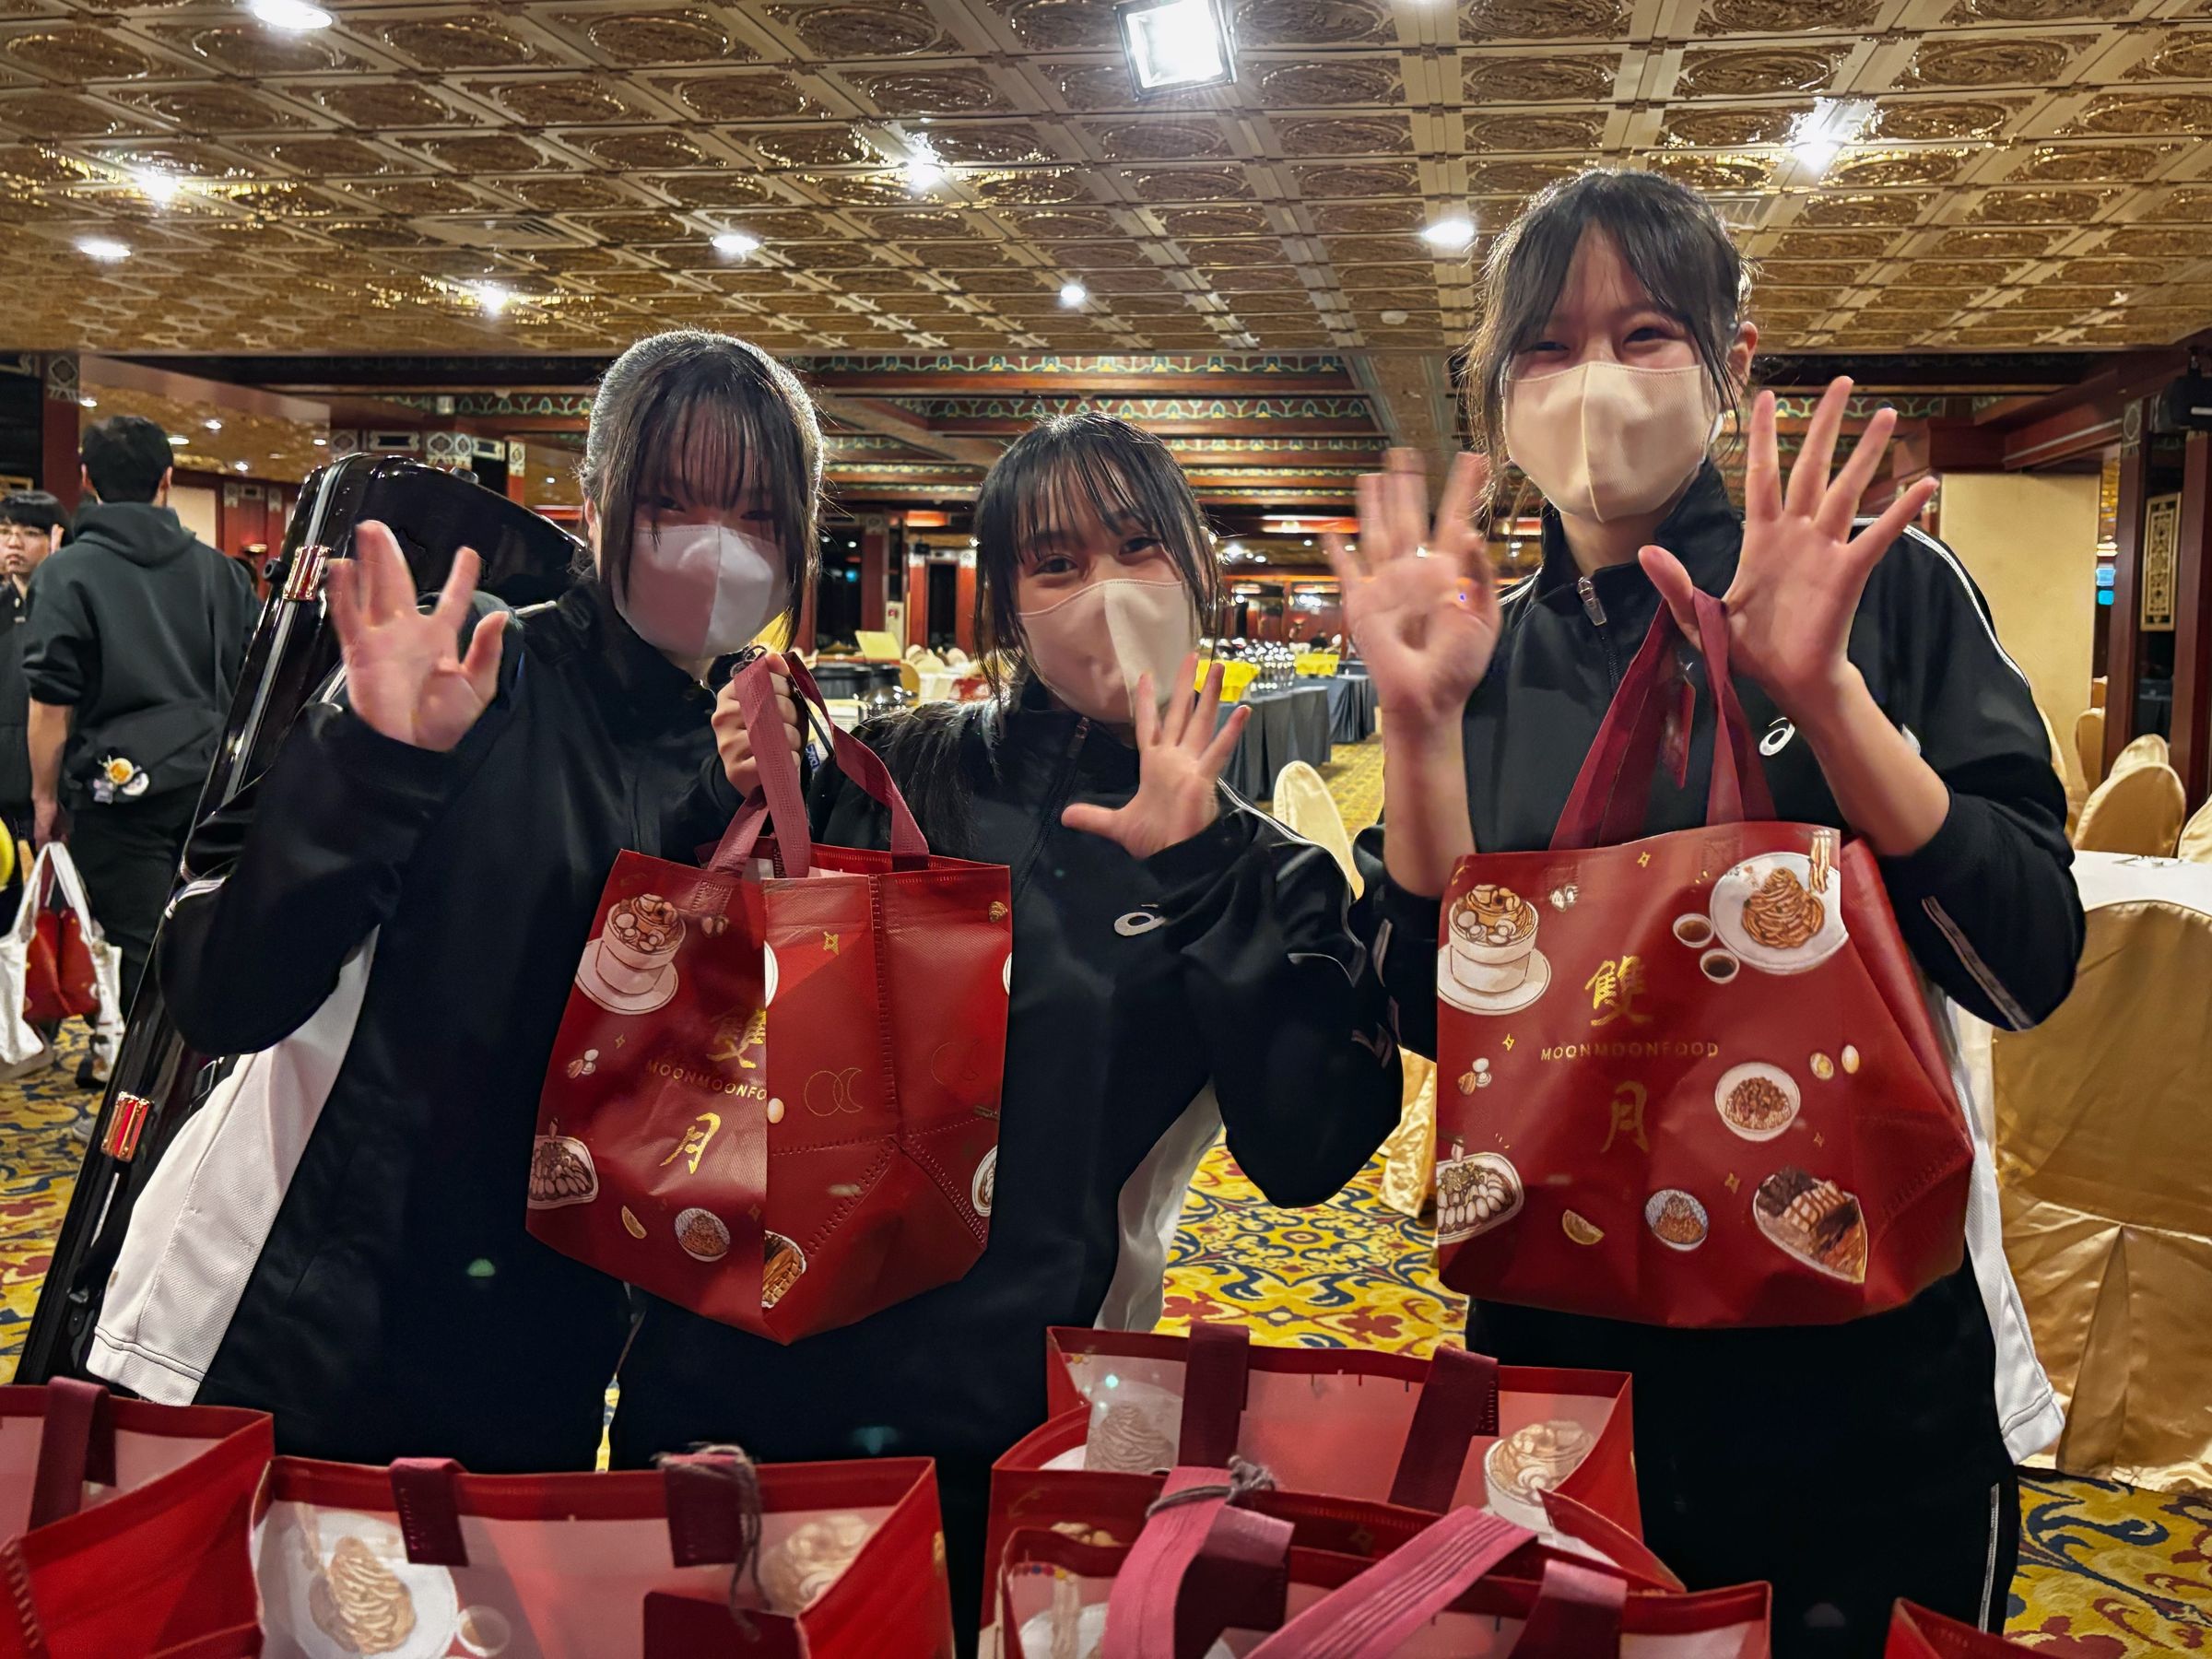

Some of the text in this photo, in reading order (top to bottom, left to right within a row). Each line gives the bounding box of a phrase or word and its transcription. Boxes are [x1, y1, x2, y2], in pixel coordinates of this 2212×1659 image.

[1540, 1041, 1719, 1061] MOONMOONFOOD
[659, 1112, 722, 1175] 月
[1600, 1079, 1649, 1154] 月
